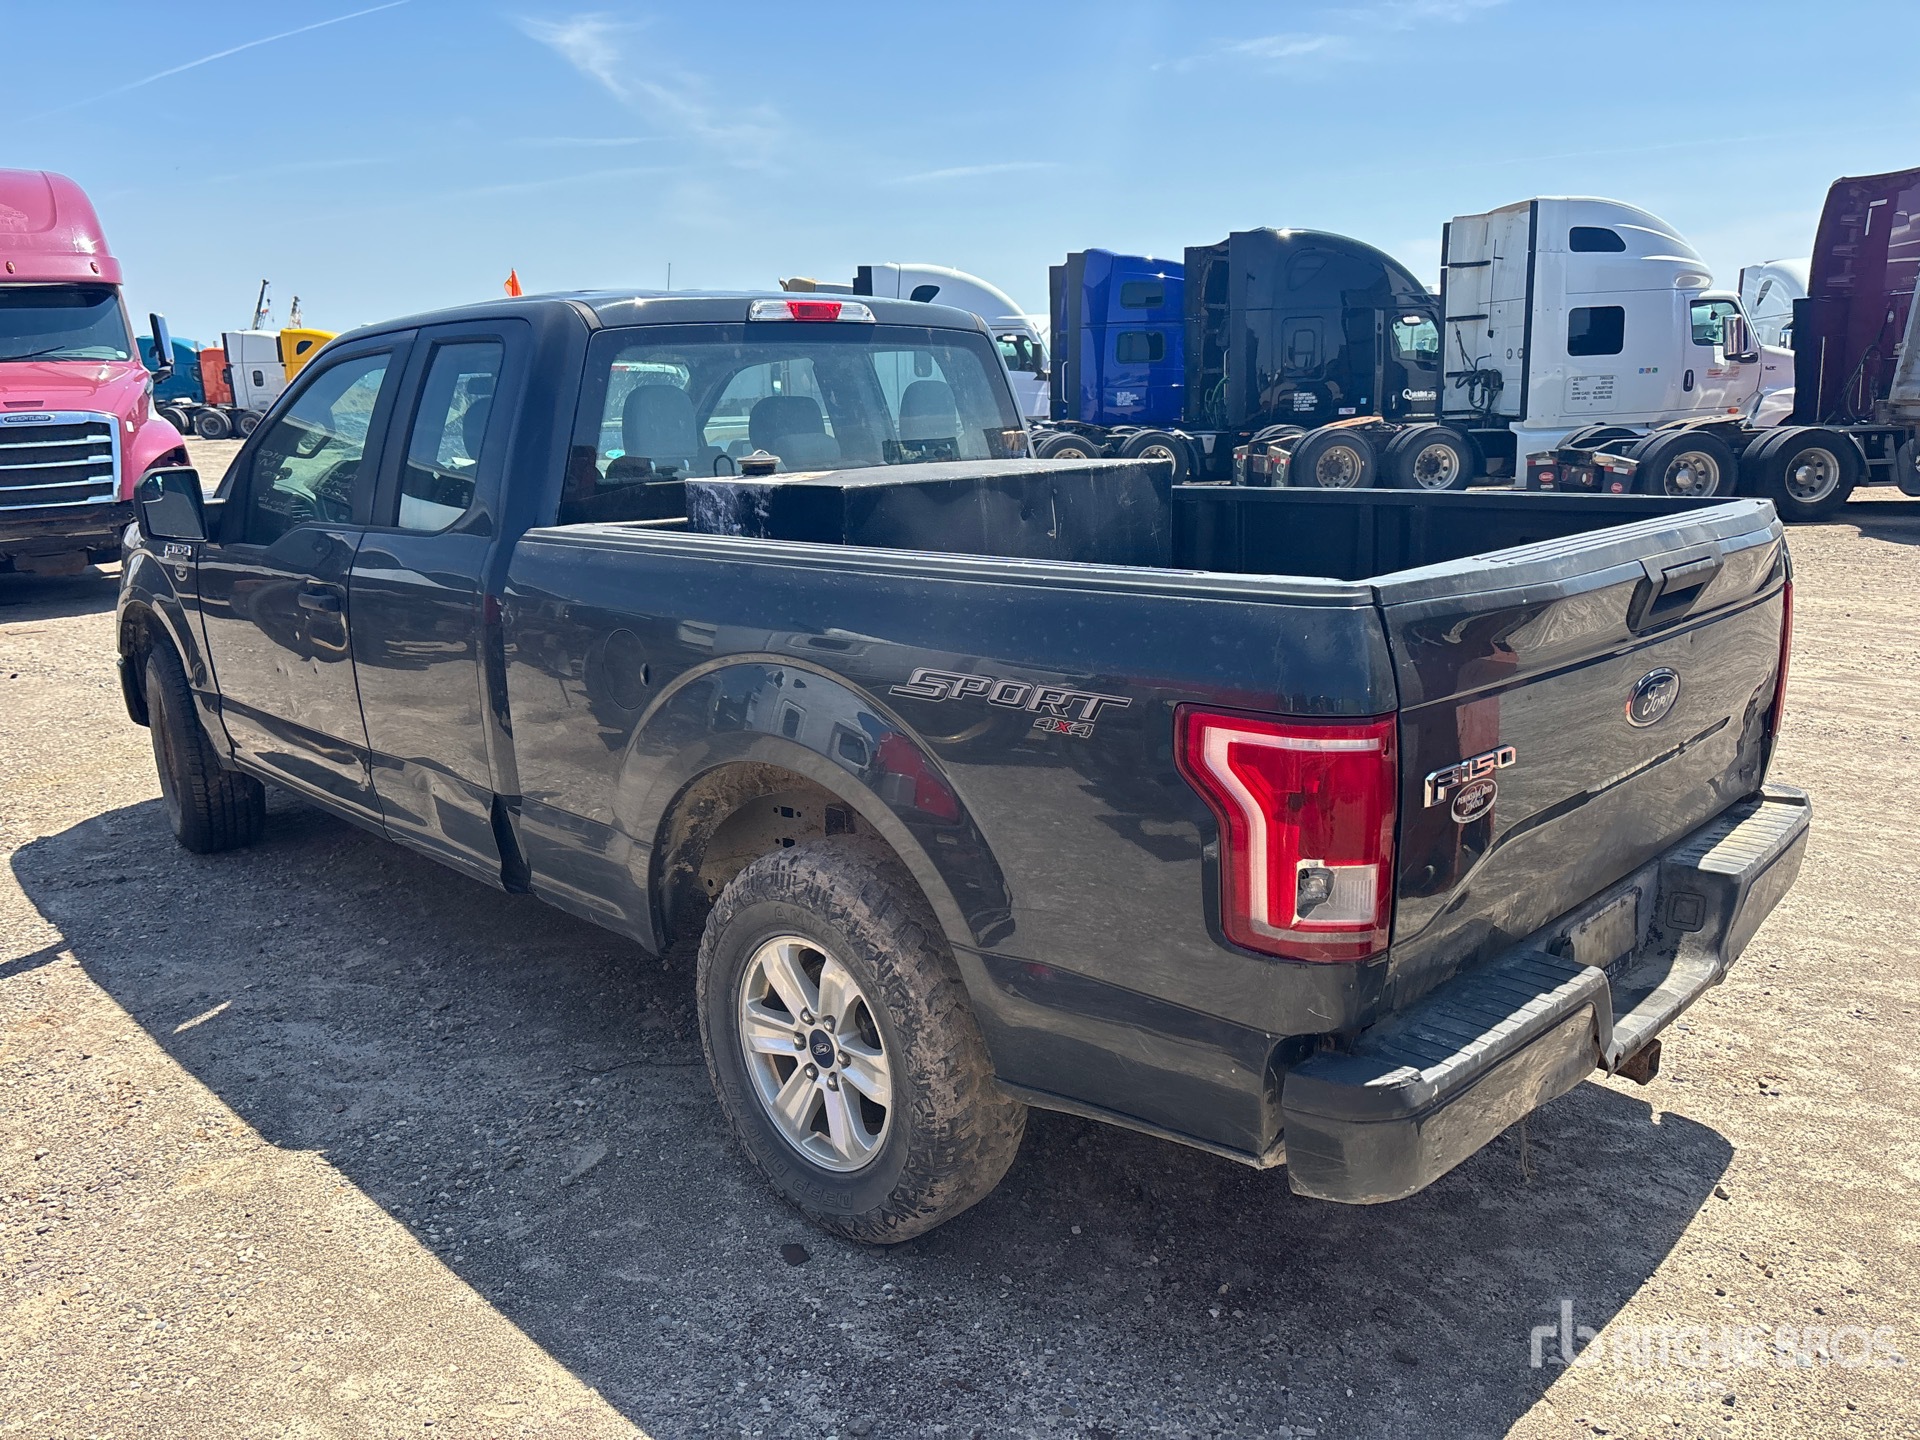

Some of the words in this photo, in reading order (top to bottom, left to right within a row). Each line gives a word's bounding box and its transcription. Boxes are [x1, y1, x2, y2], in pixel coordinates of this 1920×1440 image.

[888, 667, 1133, 721] SPORT
[1642, 681, 1673, 716] Ford
[792, 1178, 854, 1210] DEEP
